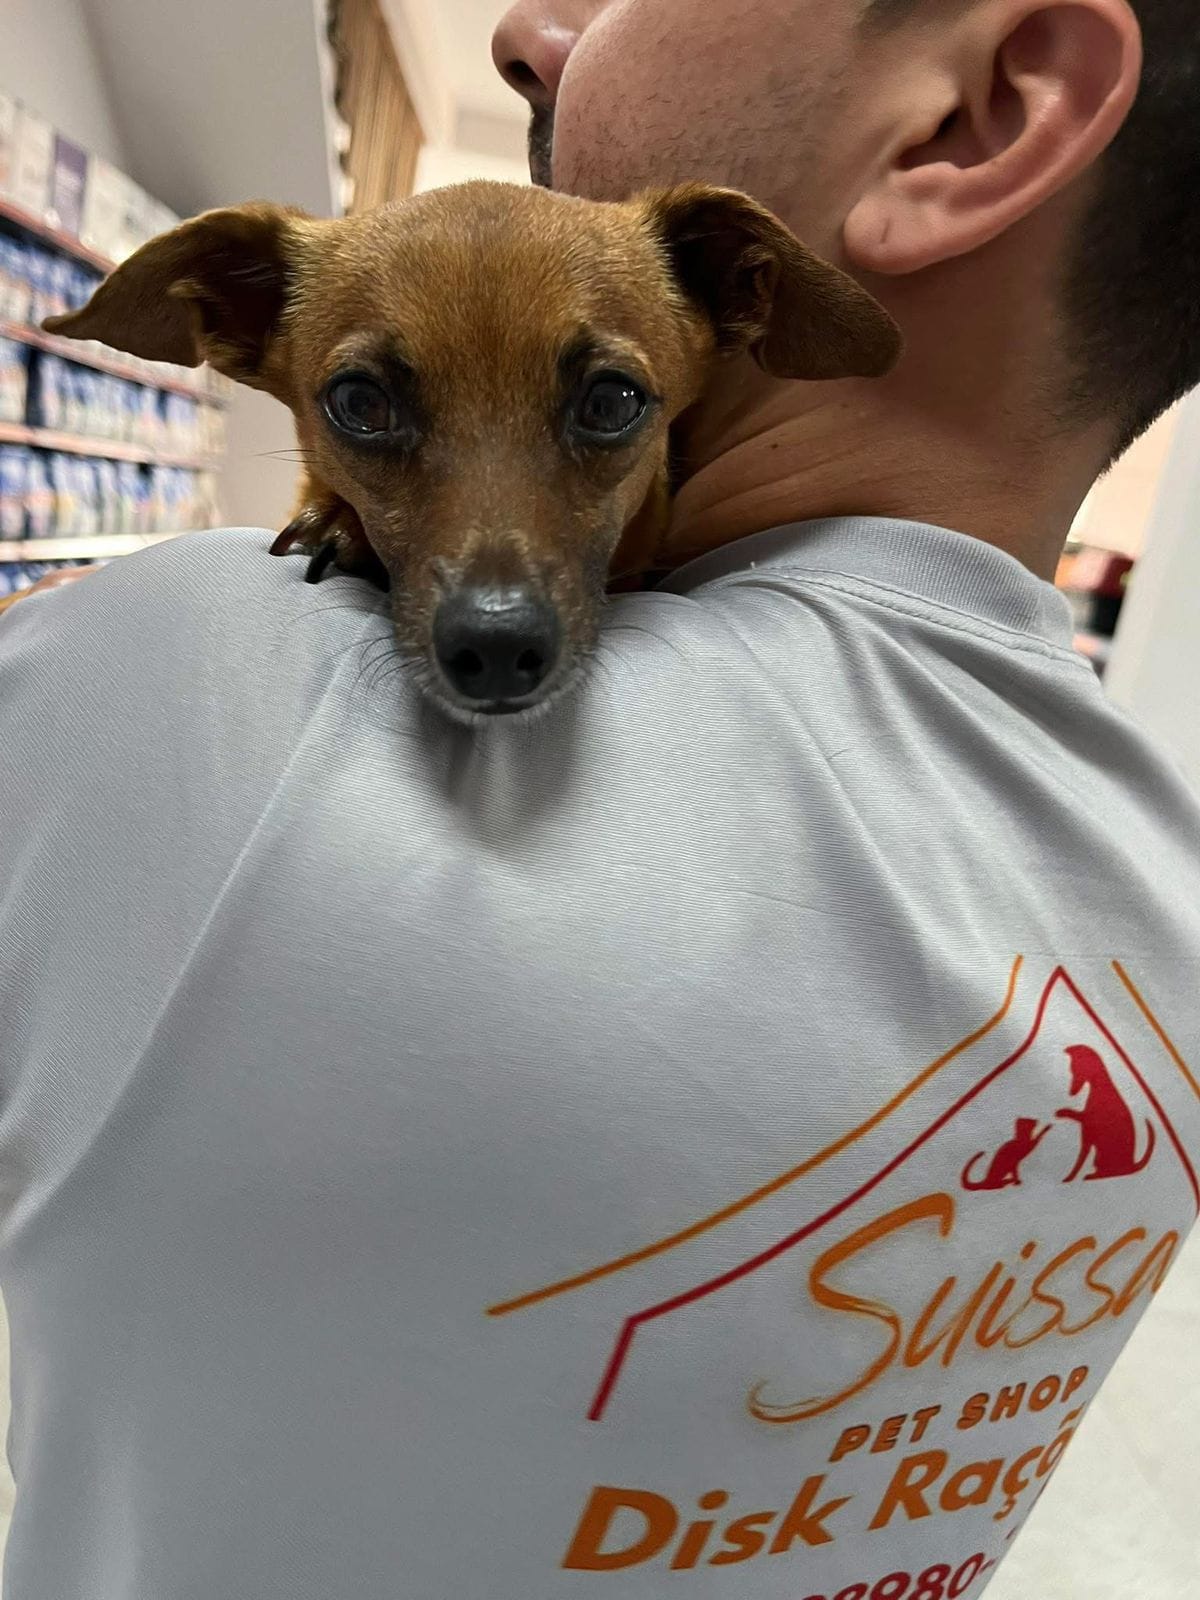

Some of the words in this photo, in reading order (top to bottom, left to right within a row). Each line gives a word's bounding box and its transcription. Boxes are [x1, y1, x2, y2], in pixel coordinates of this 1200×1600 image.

[828, 1405, 941, 1463] PET
[956, 1365, 1089, 1431] SHOP
[562, 1474, 852, 1572] Disk
